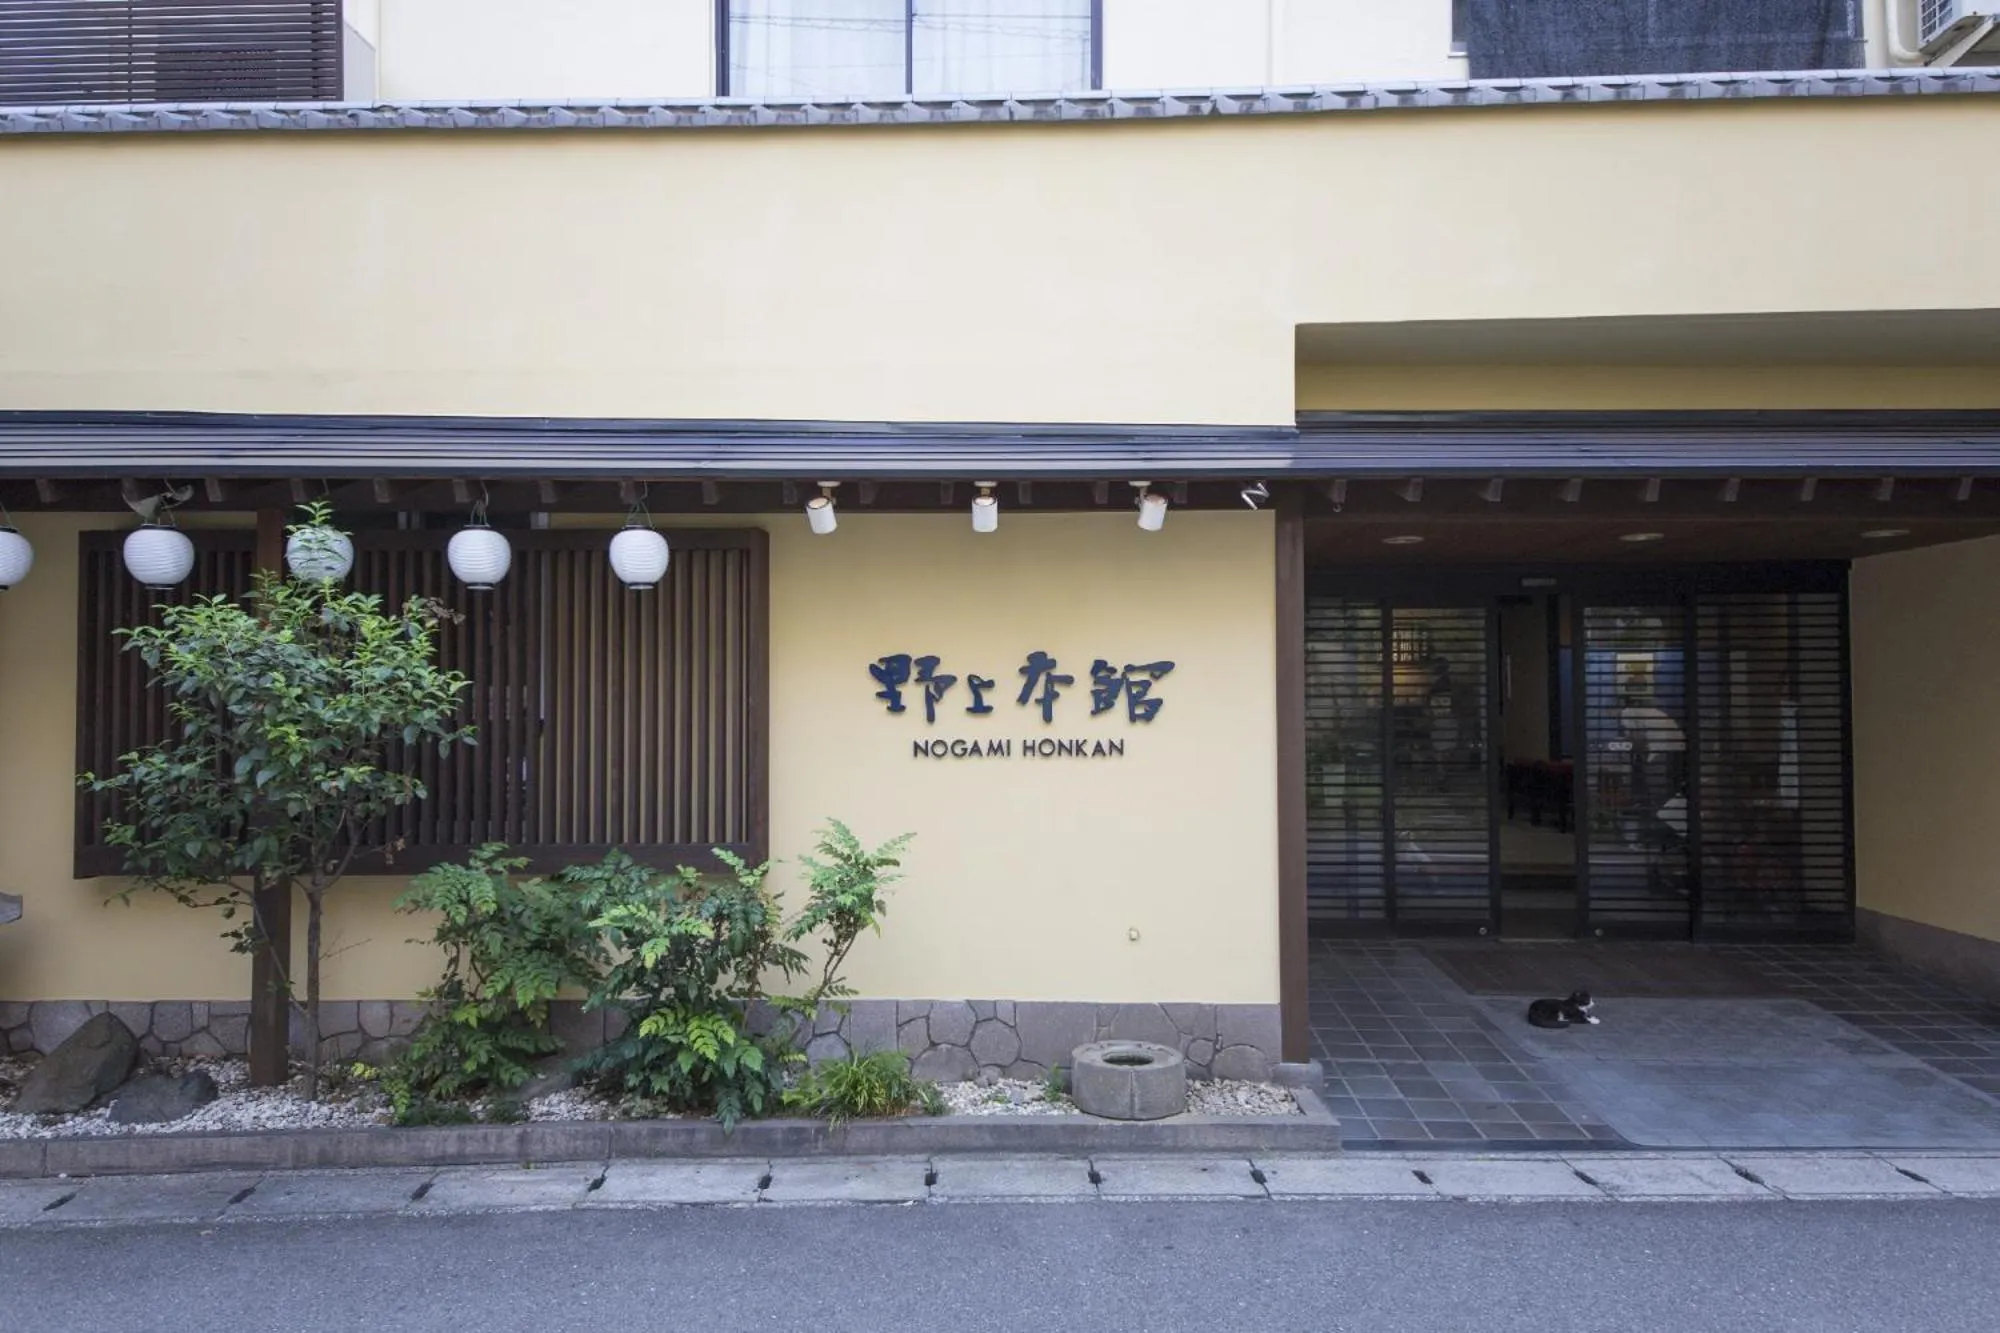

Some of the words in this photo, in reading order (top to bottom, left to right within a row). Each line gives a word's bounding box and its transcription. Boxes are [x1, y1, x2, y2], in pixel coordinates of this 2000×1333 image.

[869, 651, 1175, 723] 野上本館
[913, 739, 1011, 758] NOGAMI
[1023, 739, 1124, 758] HONKAN
